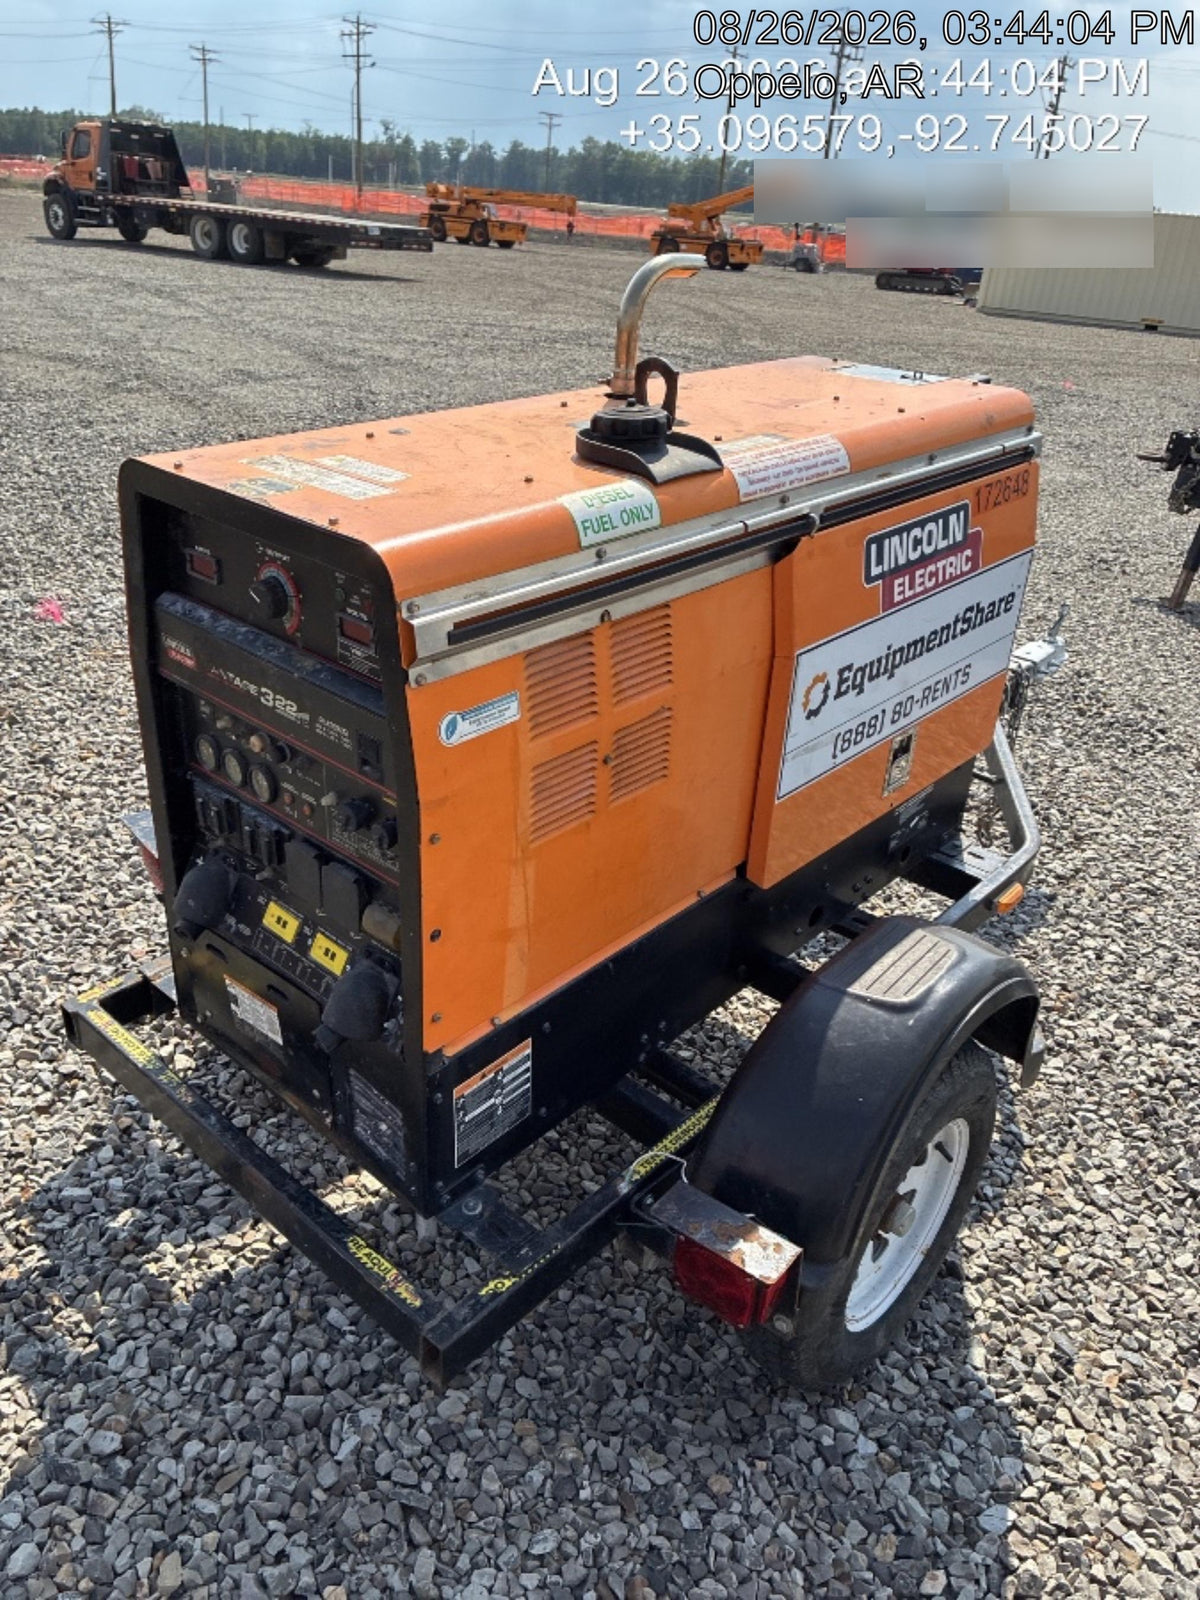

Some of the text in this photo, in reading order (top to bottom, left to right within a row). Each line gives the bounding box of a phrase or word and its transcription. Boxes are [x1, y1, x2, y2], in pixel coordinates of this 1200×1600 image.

[581, 486, 635, 509] DIESEL
[974, 469, 1031, 513] 172648
[581, 502, 654, 537] FUEL ONLY
[869, 509, 966, 578] LINCOLN
[893, 548, 973, 604] ELECTRIC
[832, 590, 1016, 701] EquipmentShare
[259, 686, 298, 713] 322
[831, 662, 972, 760] (888) 80-RENTS
